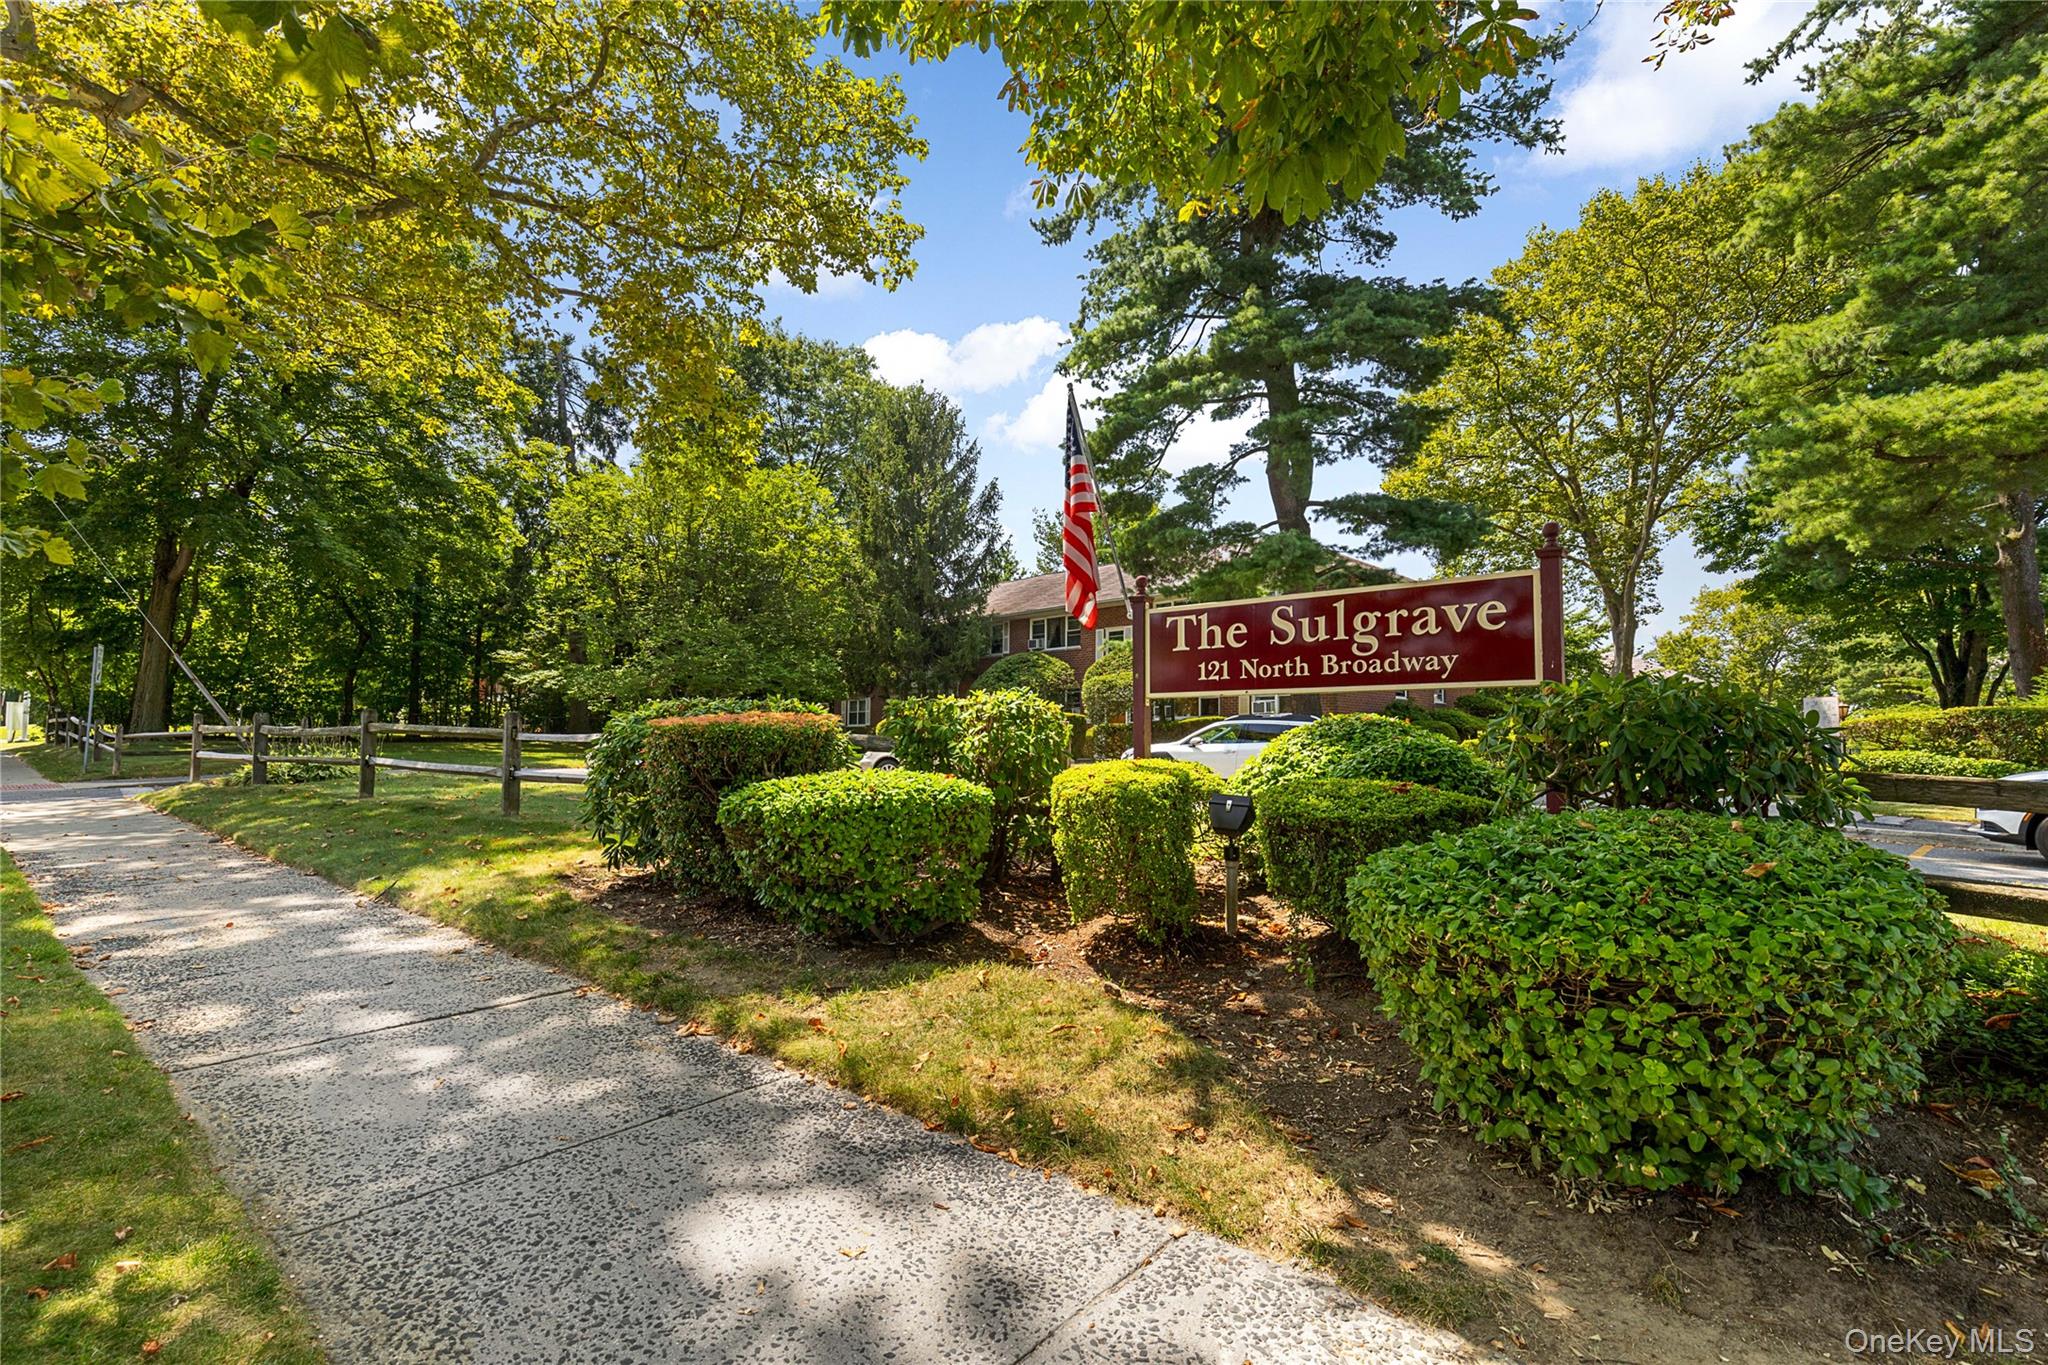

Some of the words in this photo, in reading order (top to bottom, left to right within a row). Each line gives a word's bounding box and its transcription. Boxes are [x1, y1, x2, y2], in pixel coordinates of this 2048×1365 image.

[1165, 612, 1249, 652] The
[1270, 599, 1506, 656] Sulgrave
[1197, 660, 1231, 682] 121
[1239, 655, 1310, 679] North
[1320, 651, 1459, 679] Broadway
